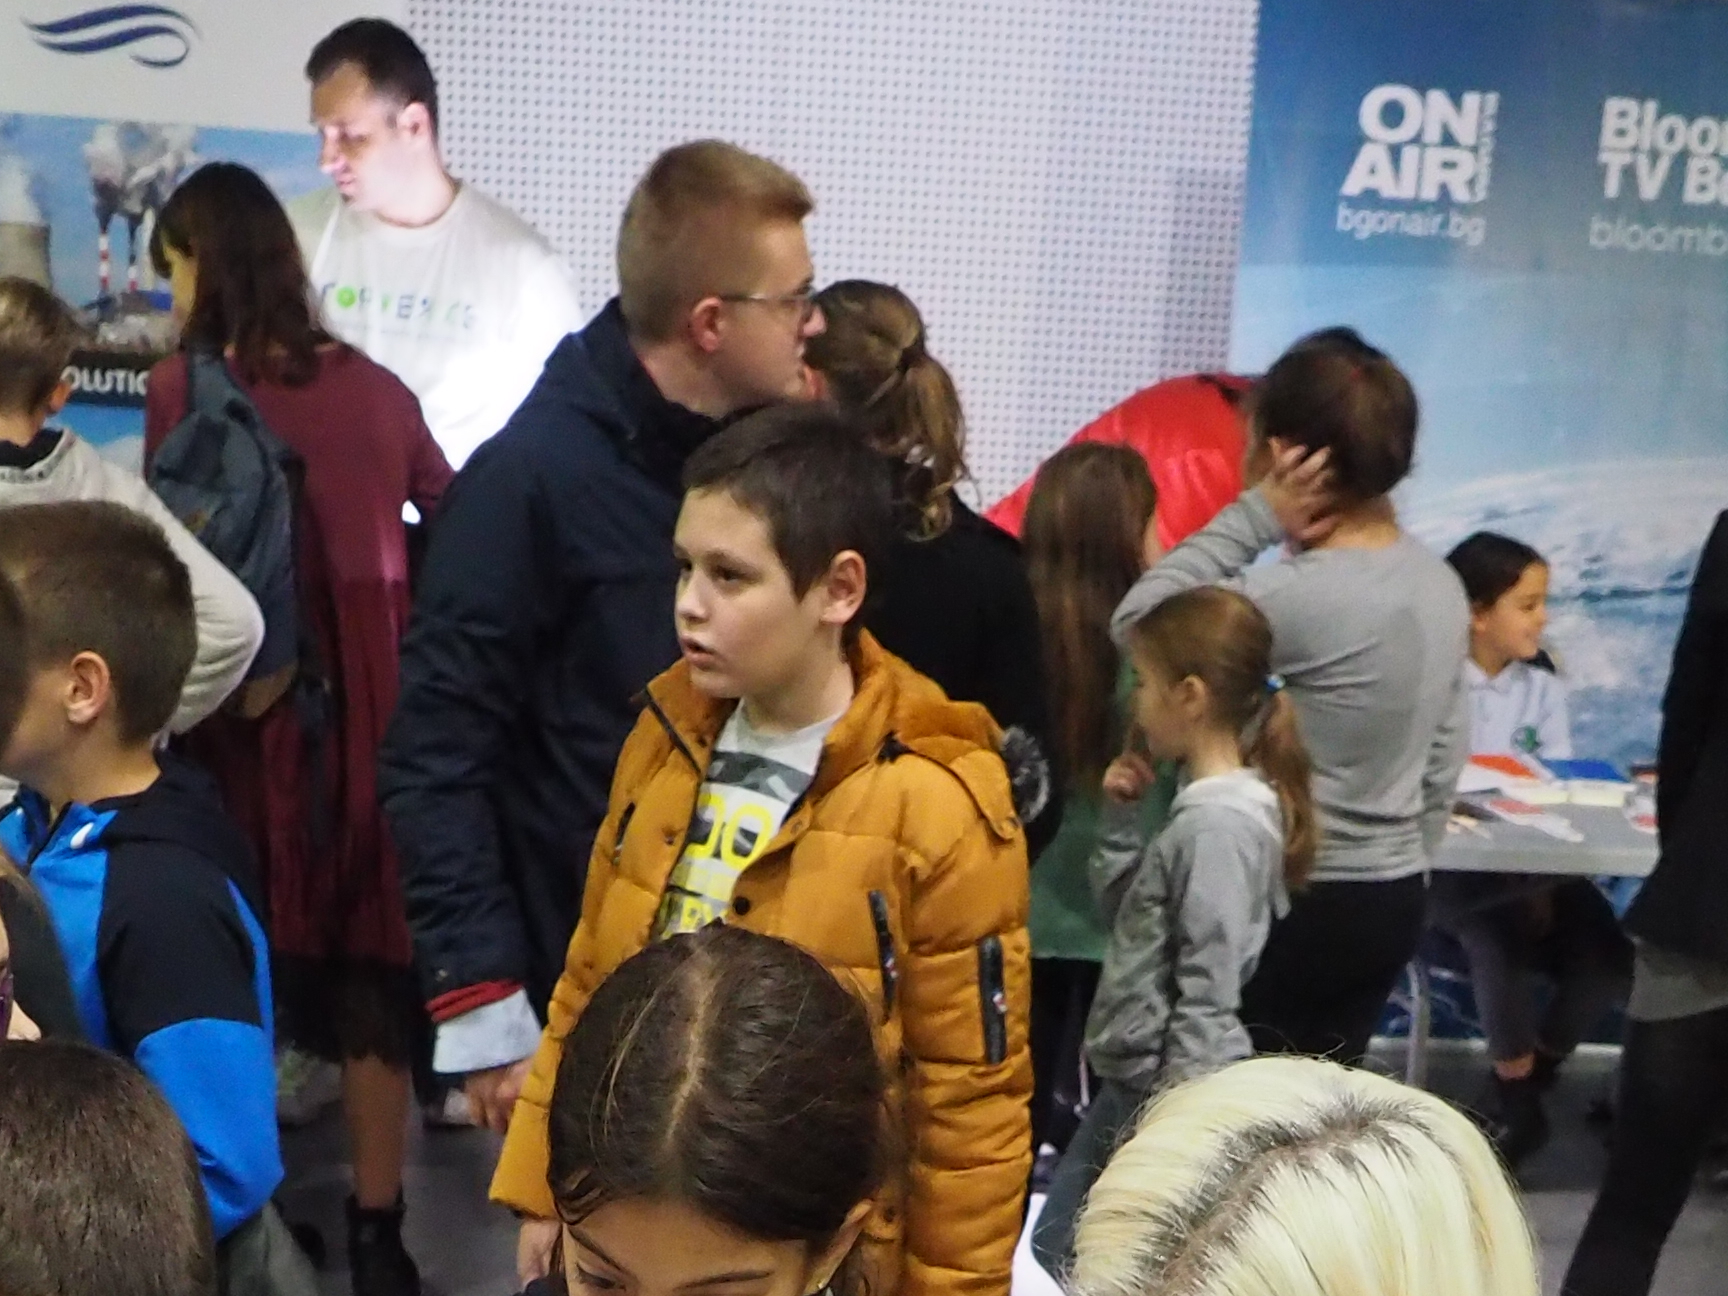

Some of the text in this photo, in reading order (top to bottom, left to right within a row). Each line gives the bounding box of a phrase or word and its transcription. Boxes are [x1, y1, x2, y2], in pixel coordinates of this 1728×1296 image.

[1359, 84, 1484, 145] ON
[1339, 142, 1479, 203] AIR
[1597, 150, 1674, 201] TV
[1335, 202, 1486, 247] bgonair.bg
